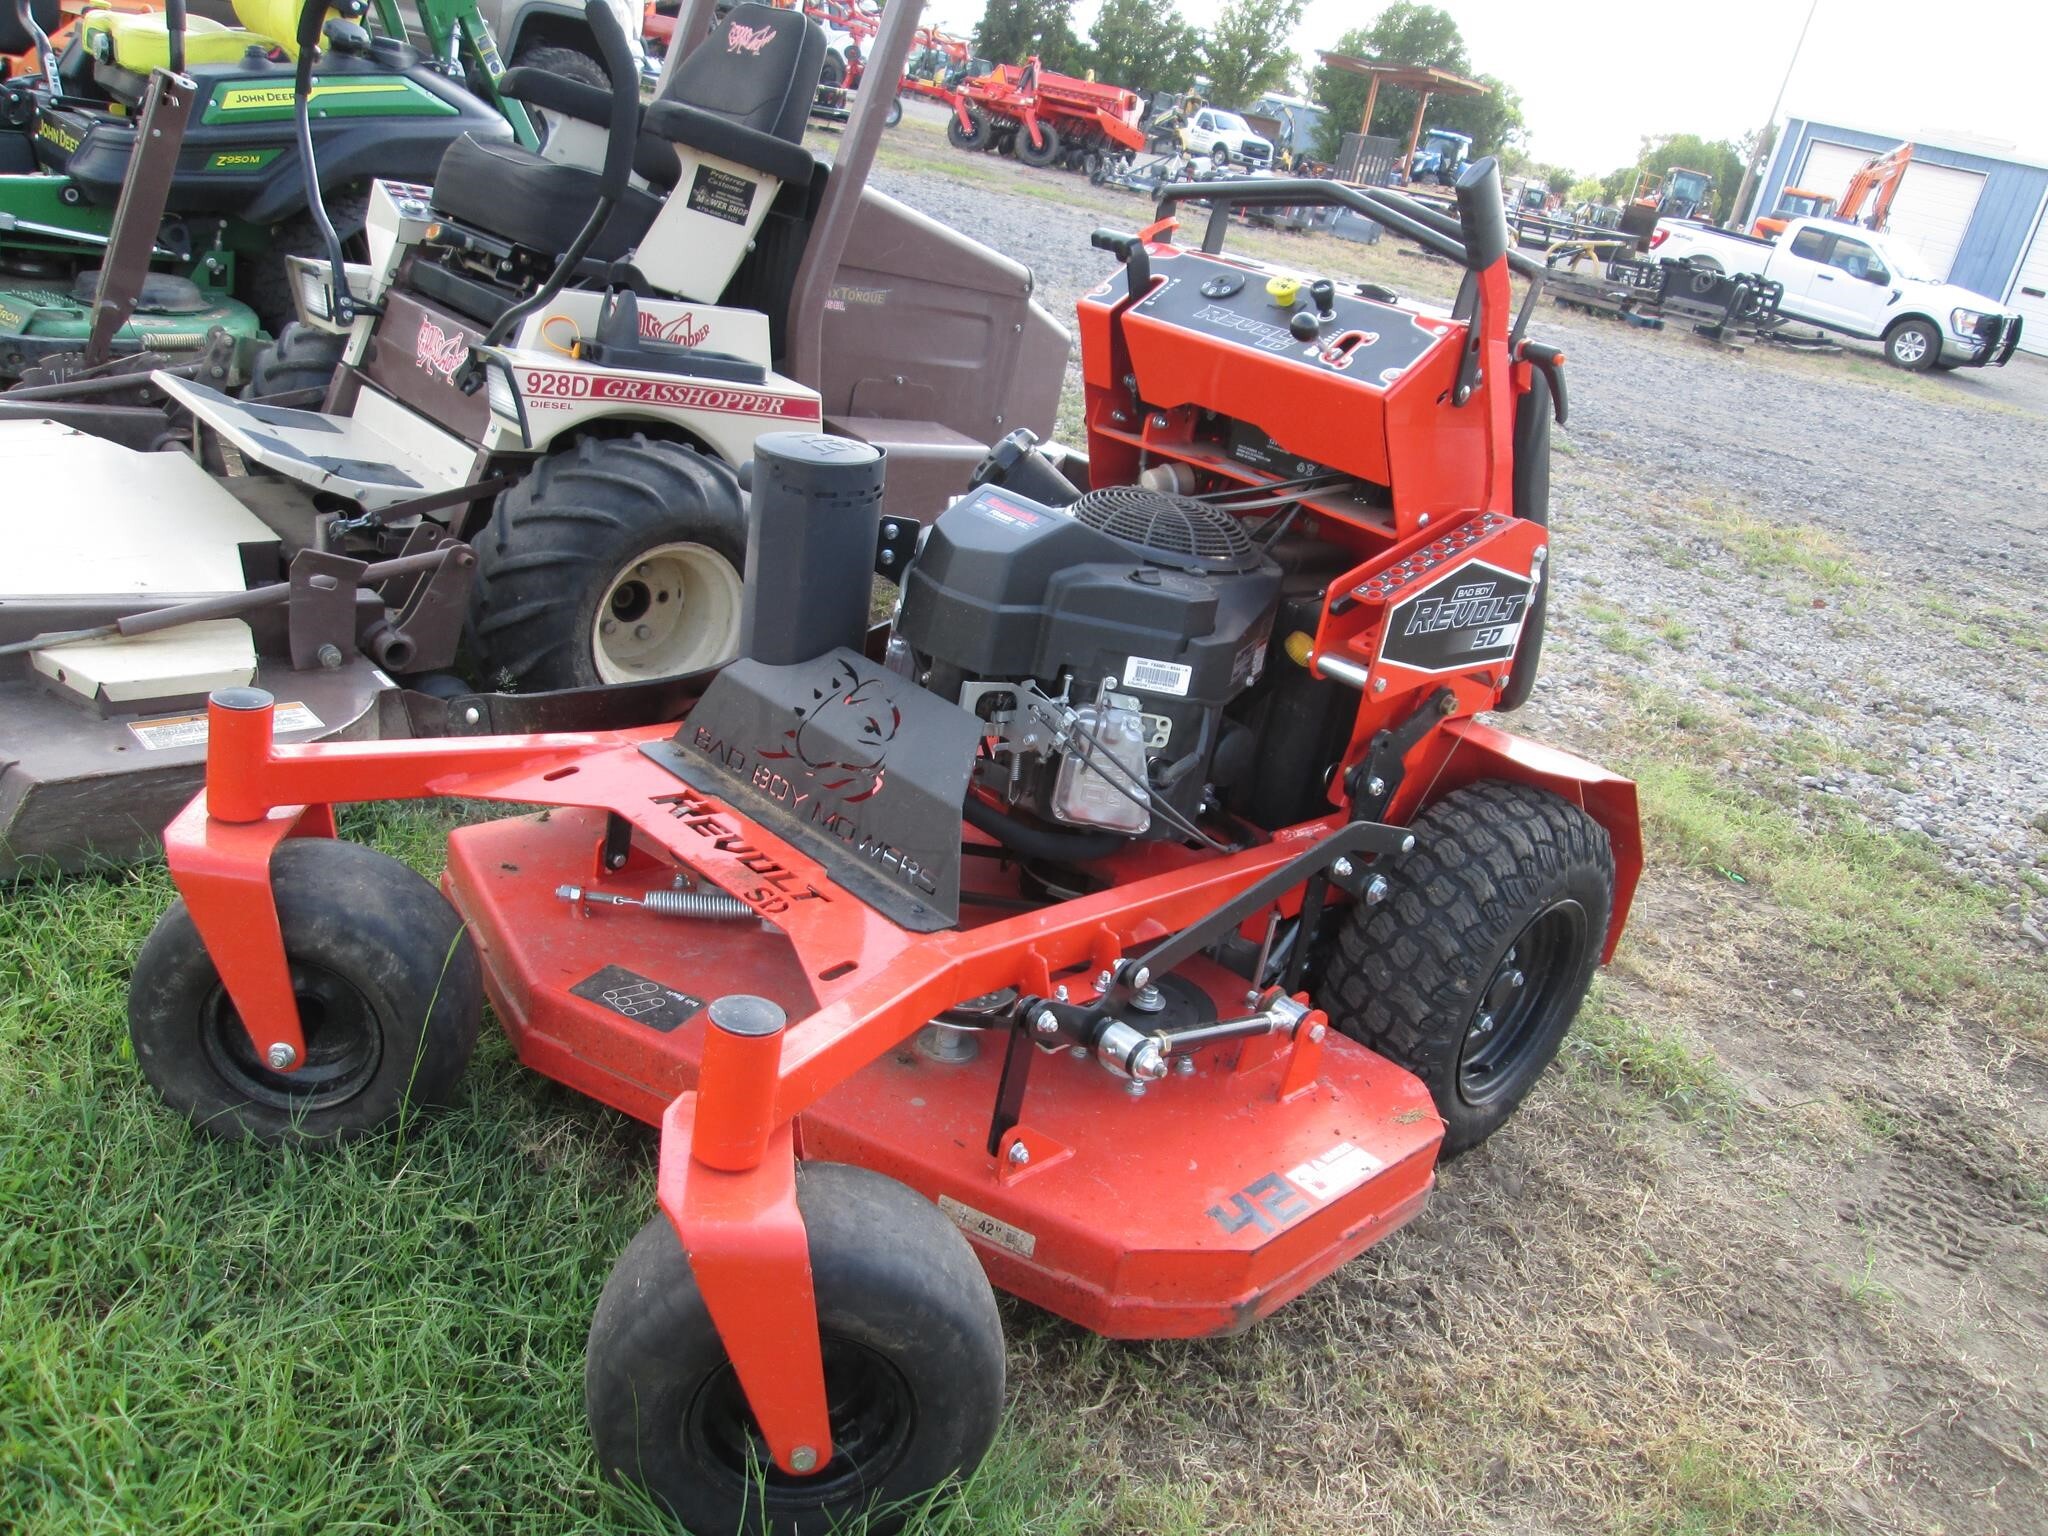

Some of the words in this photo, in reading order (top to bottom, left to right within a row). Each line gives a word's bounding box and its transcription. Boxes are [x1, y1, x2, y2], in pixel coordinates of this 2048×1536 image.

[236, 93, 267, 103] JOHN
[267, 92, 296, 102] DEER
[38, 119, 59, 144] JOHN
[216, 154, 261, 167] Z950M
[707, 177, 744, 193] Customer
[710, 169, 747, 187] Preferred
[727, 203, 749, 217] SHOP
[1192, 304, 1298, 344] REVOL
[526, 371, 591, 398] 928D
[603, 379, 786, 414] GRASSHOPPER
[530, 400, 575, 411] DIESEL
[1457, 588, 1475, 598] BAD
[1475, 587, 1491, 597] BOY
[1404, 594, 1526, 636] REVOLT
[1471, 627, 1504, 650] SD
[694, 727, 746, 774] BAD
[752, 762, 809, 809] BOY
[812, 801, 937, 897] MOWERS
[648, 790, 835, 903] REVOLT
[744, 887, 790, 914] SD
[1204, 1171, 1312, 1235] 42
[978, 1219, 1002, 1236] 42"
